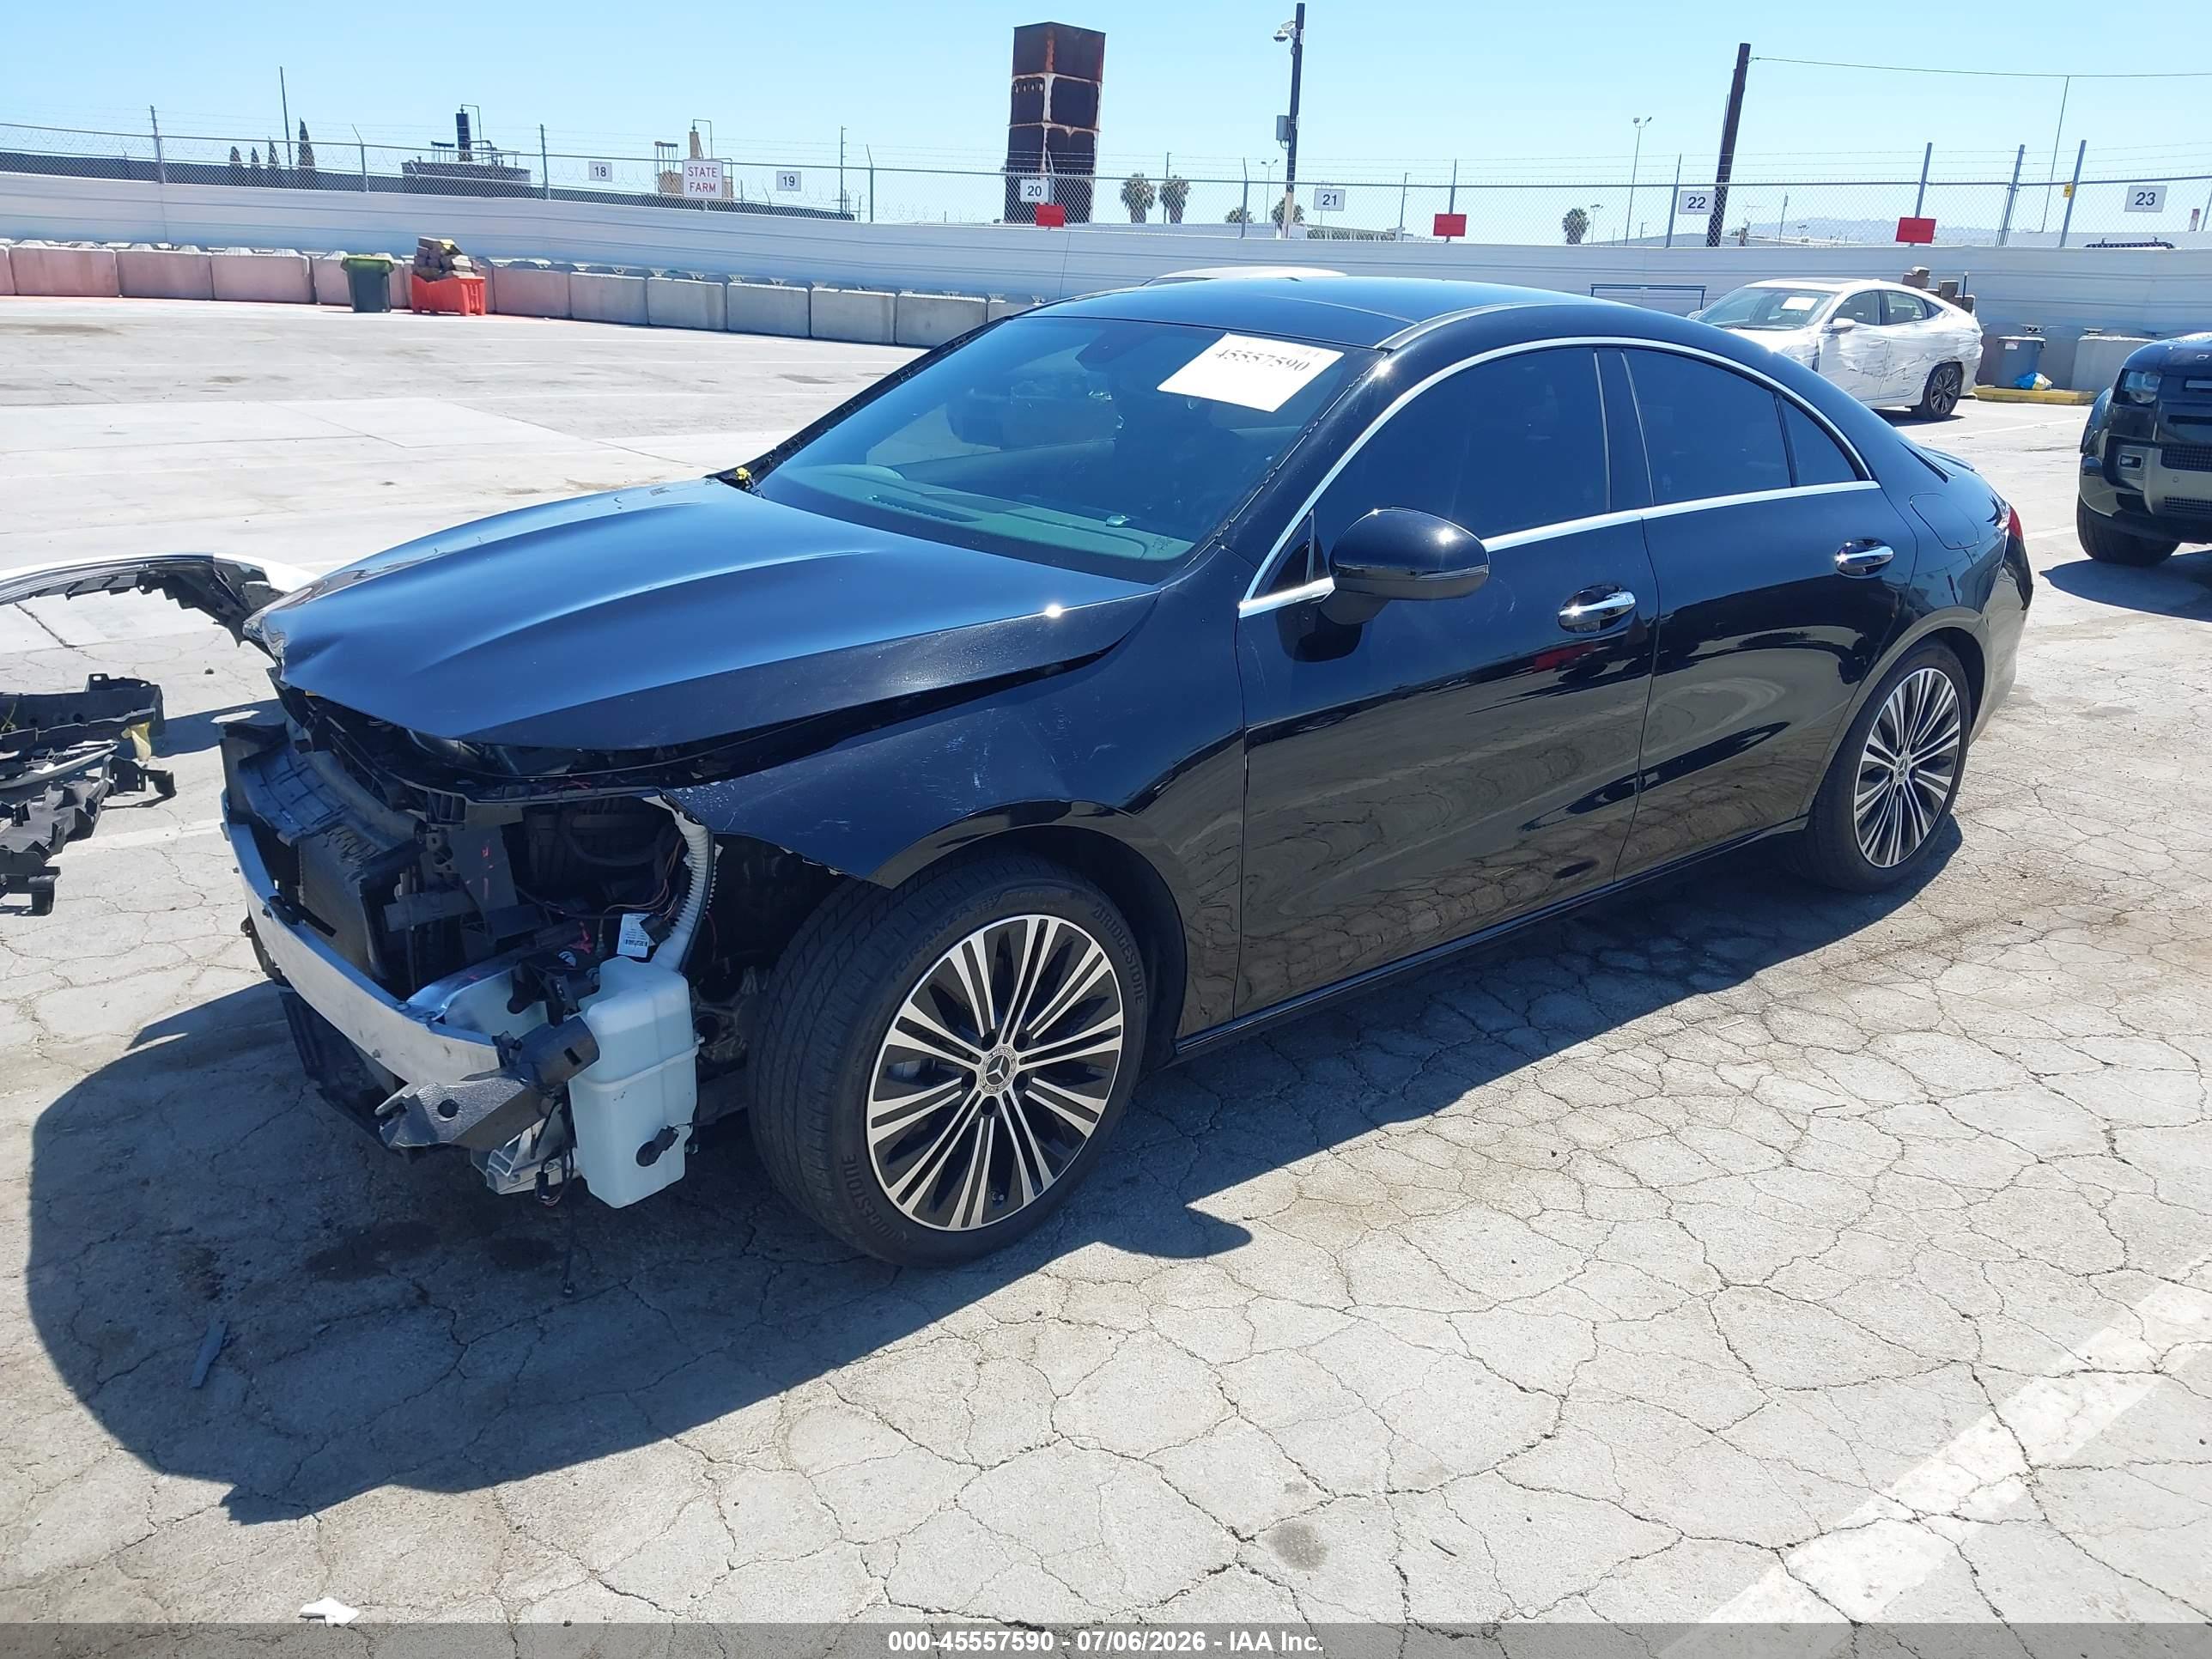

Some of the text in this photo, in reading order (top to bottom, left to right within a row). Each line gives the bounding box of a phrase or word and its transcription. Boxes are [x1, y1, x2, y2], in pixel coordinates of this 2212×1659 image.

[594, 167, 606, 177] 18
[688, 167, 718, 178] STATE
[690, 182, 716, 193] FARM
[782, 176, 795, 187] 19
[1027, 185, 1042, 197] 20
[1322, 194, 1338, 206] 21
[1687, 197, 1706, 209] 22
[2135, 191, 2156, 206] 23
[1215, 349, 1310, 372] 45557590
[1091, 902, 1146, 1006] BRIDGESTONE
